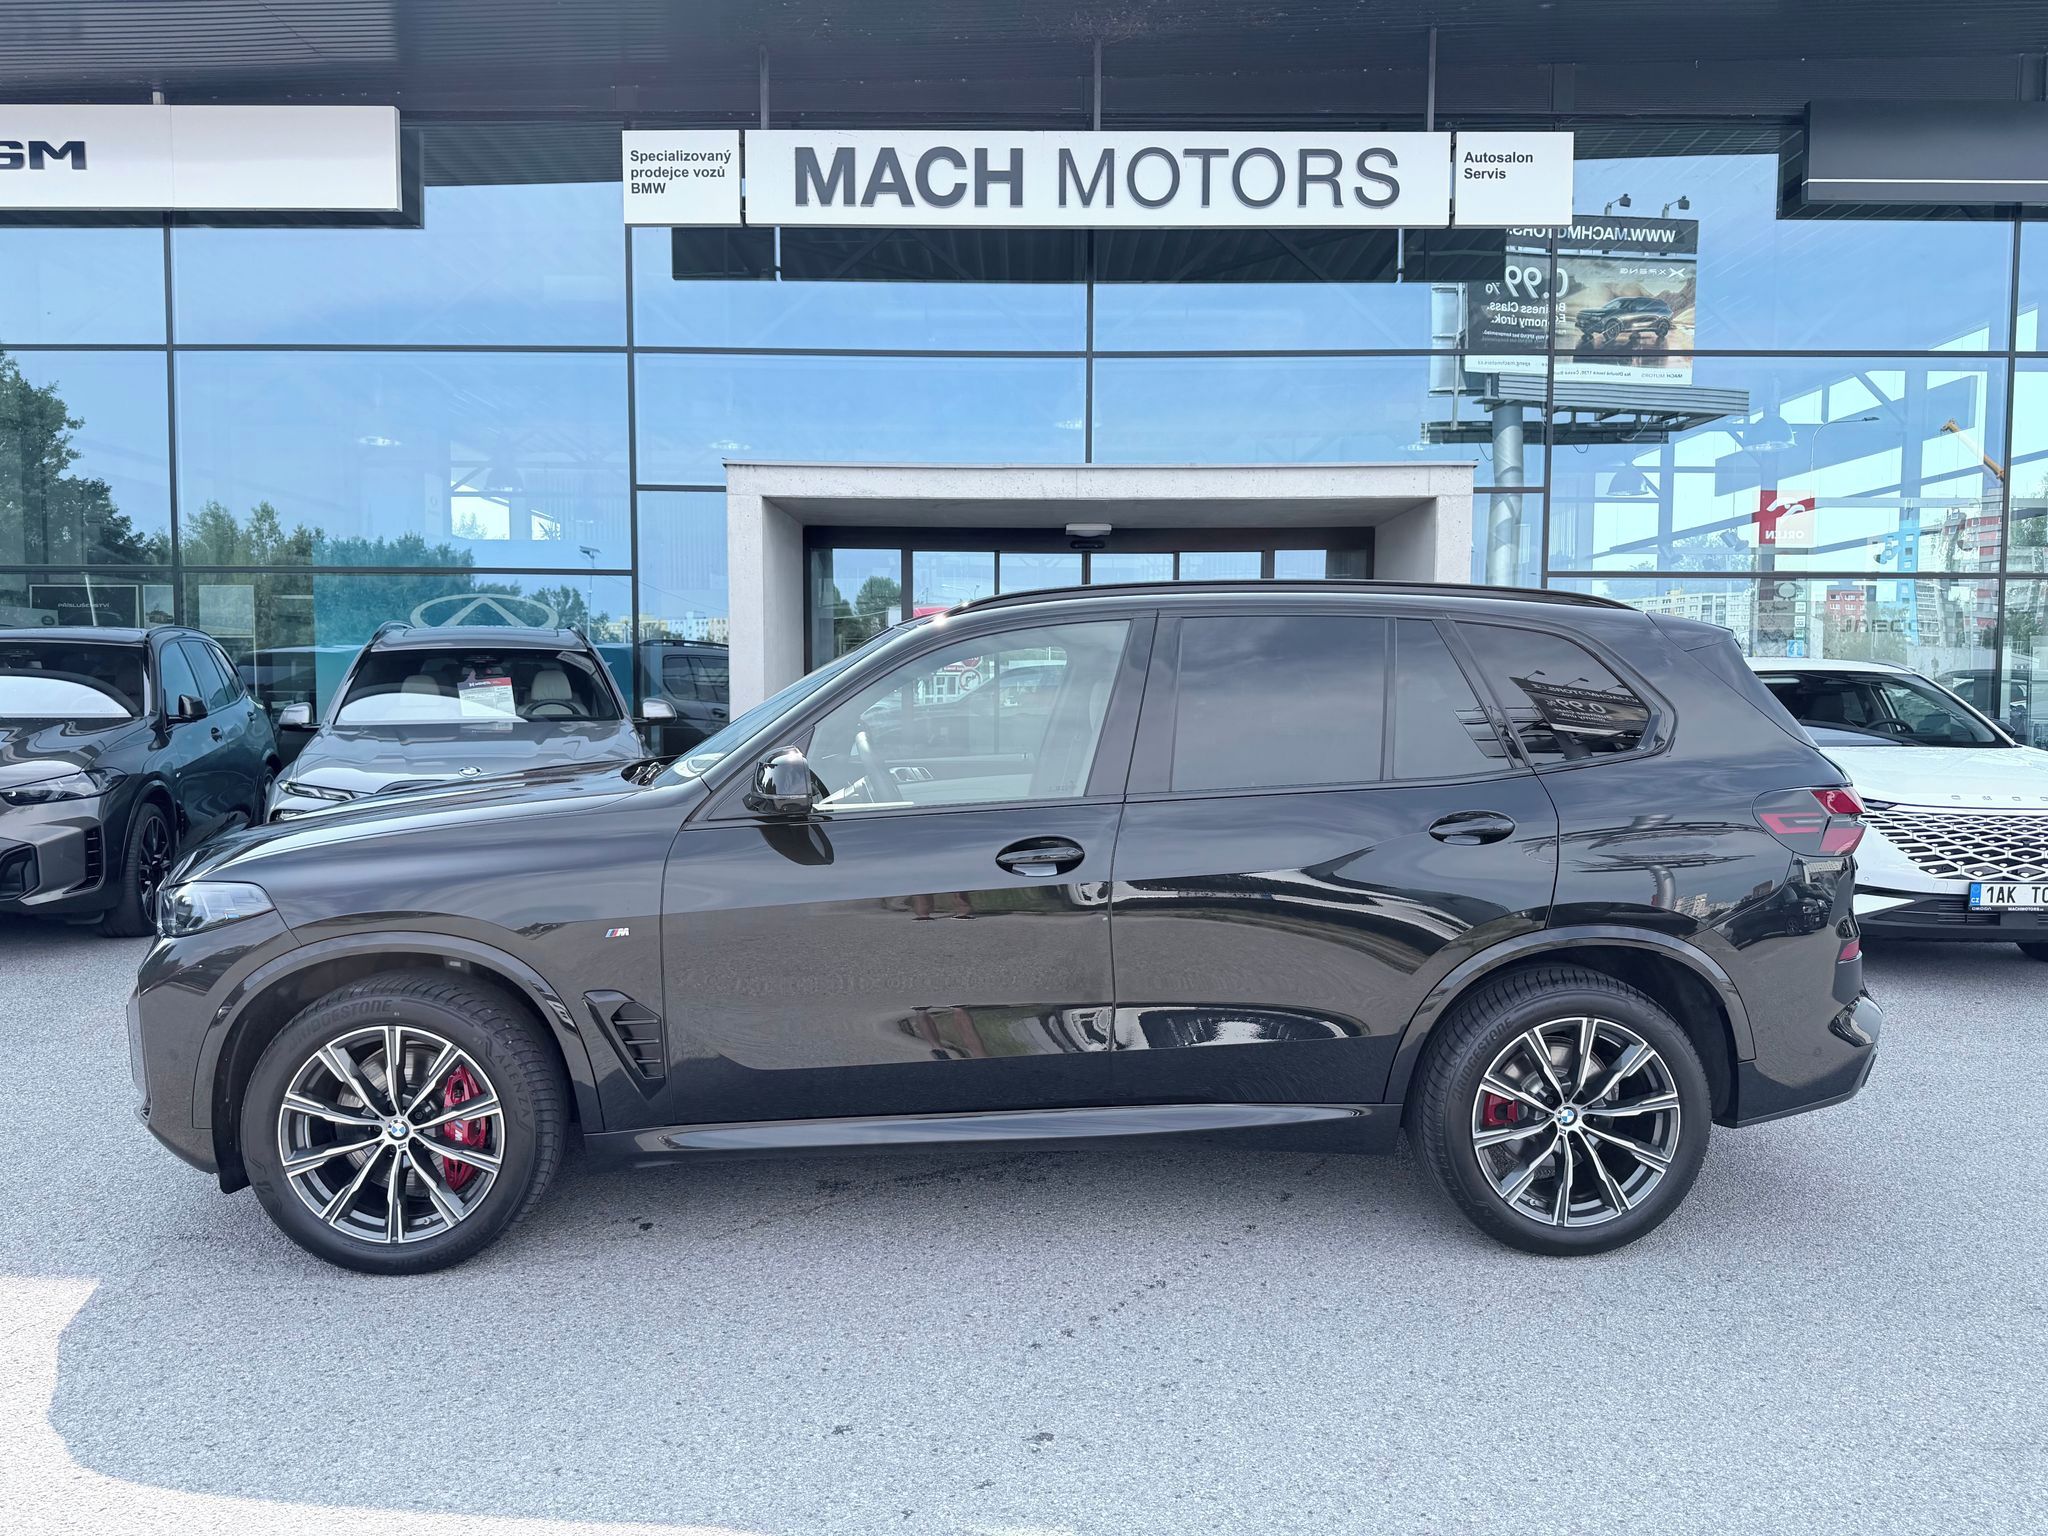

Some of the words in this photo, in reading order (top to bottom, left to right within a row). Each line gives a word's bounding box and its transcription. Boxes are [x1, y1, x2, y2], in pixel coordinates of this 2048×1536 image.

[630, 149, 731, 164] Specializovaný
[1464, 151, 1534, 163] Autosalon
[631, 166, 689, 180] prodejce
[693, 165, 725, 178] vozů
[795, 146, 1023, 208] MACH
[1058, 146, 1400, 208] MOTORS
[1464, 168, 1506, 179] Servis
[631, 182, 666, 194] BMW
[1986, 886, 2016, 903] 1AK
